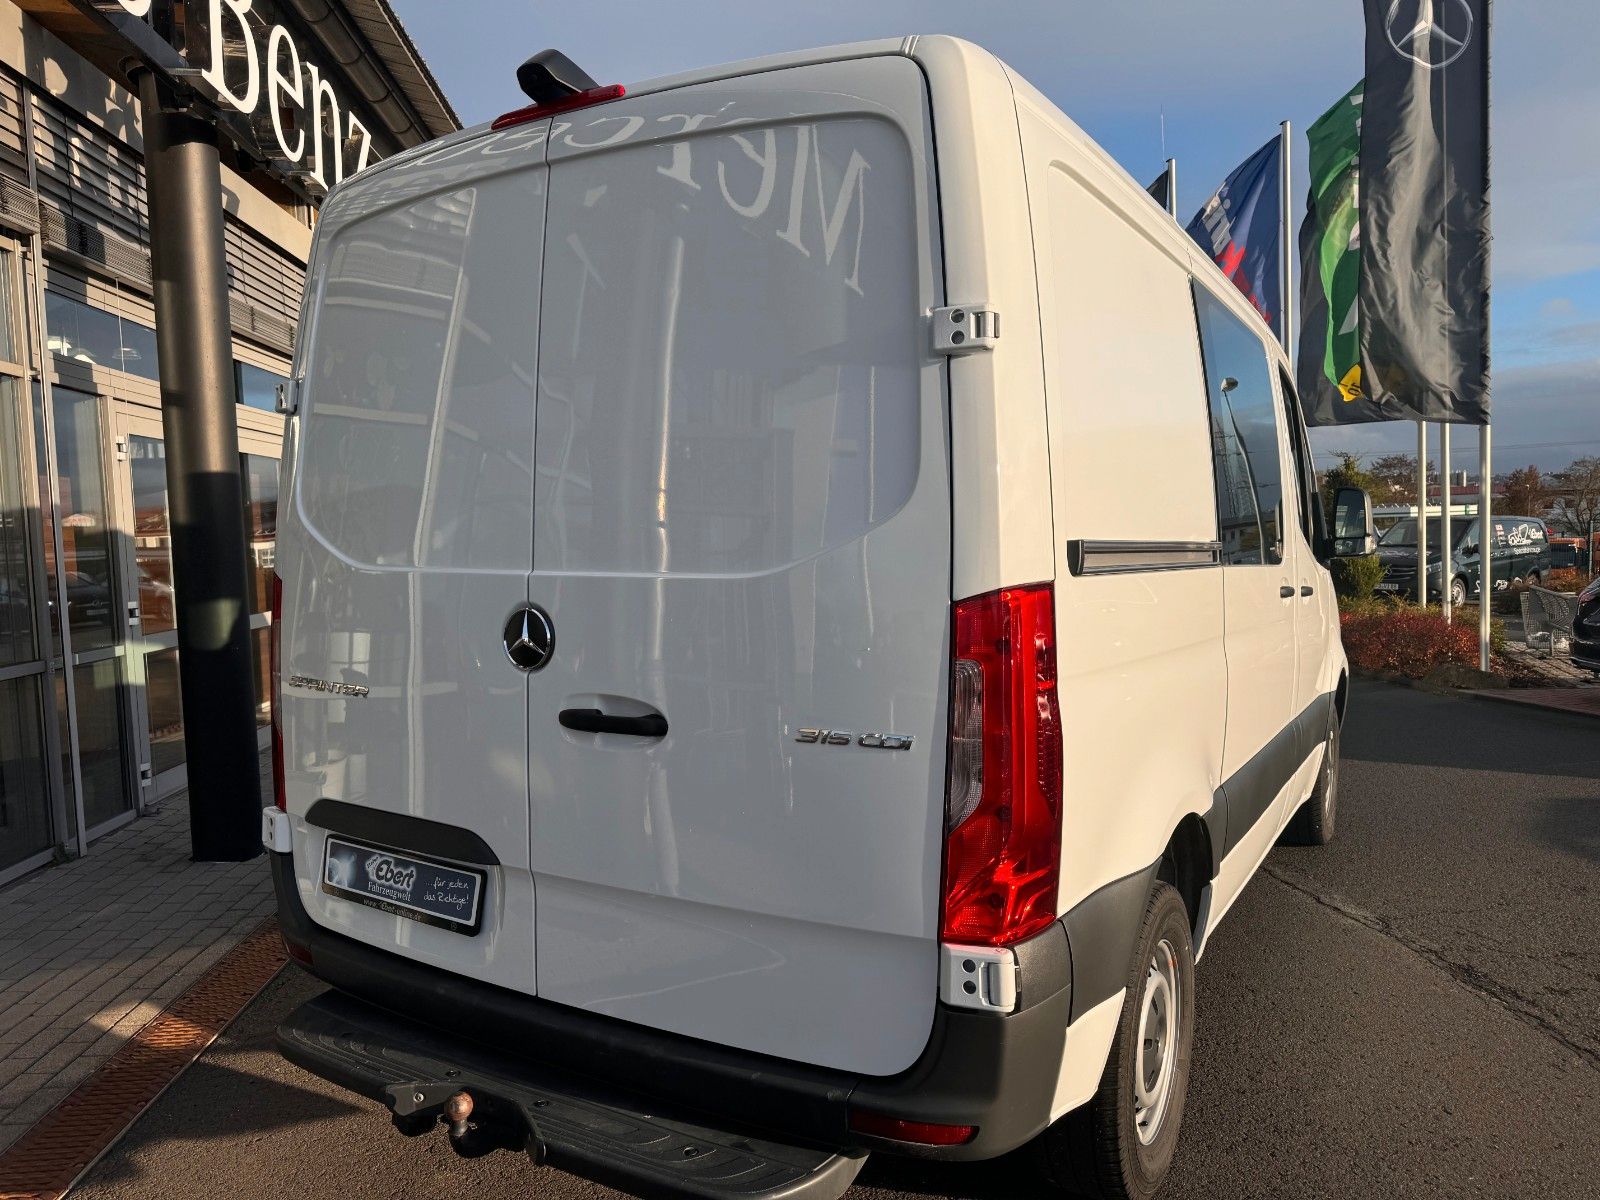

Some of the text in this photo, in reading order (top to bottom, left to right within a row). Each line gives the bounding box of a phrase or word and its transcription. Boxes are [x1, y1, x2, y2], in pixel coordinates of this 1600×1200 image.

[201, 0, 372, 192] Benz
[288, 675, 369, 698] SPRINTER
[794, 727, 915, 751] 315 CDI
[375, 859, 415, 889] Ebert
[367, 881, 411, 901] Fahrzeugwelt
[423, 890, 436, 901] das
